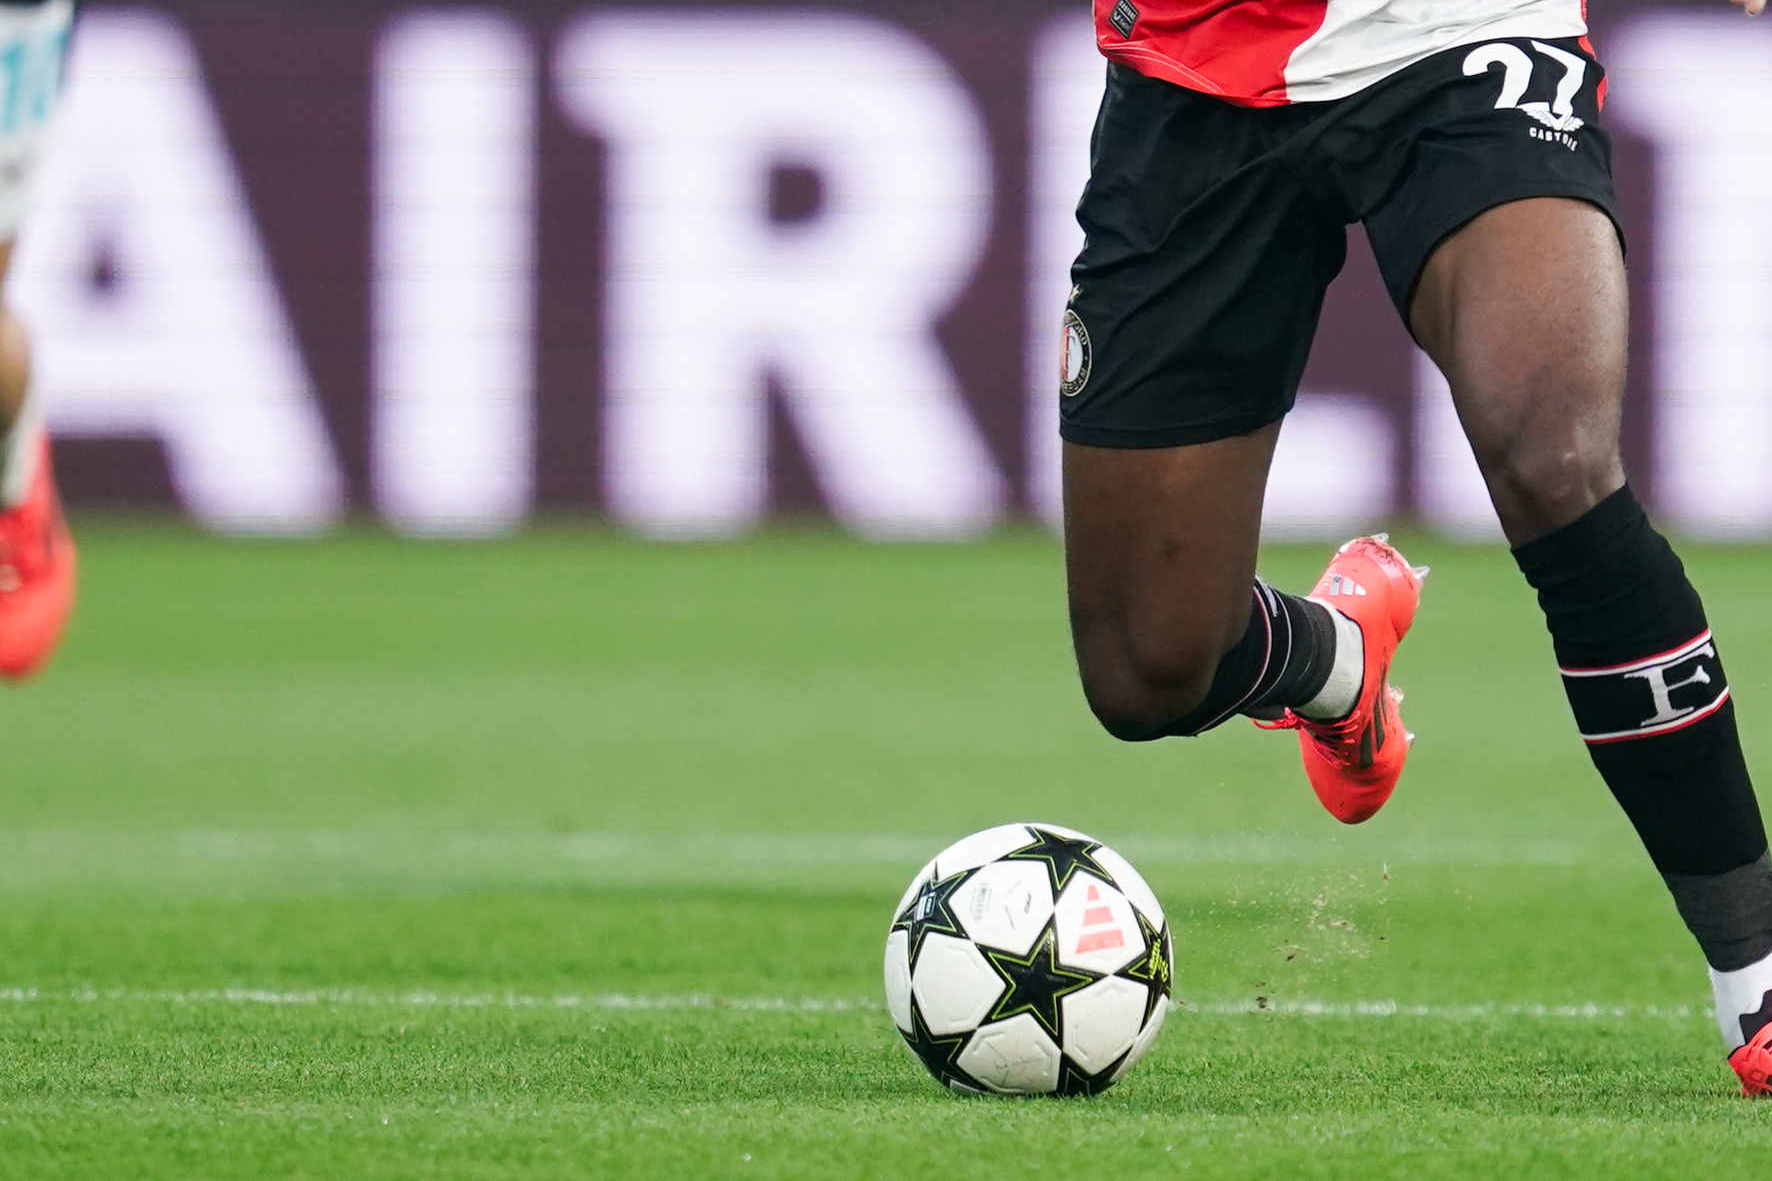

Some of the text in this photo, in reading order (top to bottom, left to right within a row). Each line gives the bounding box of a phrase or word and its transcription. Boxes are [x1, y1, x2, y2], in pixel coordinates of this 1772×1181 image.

[1462, 40, 1587, 118] 27
[1529, 127, 1579, 151] CASTORE
[1624, 641, 1716, 728] F
